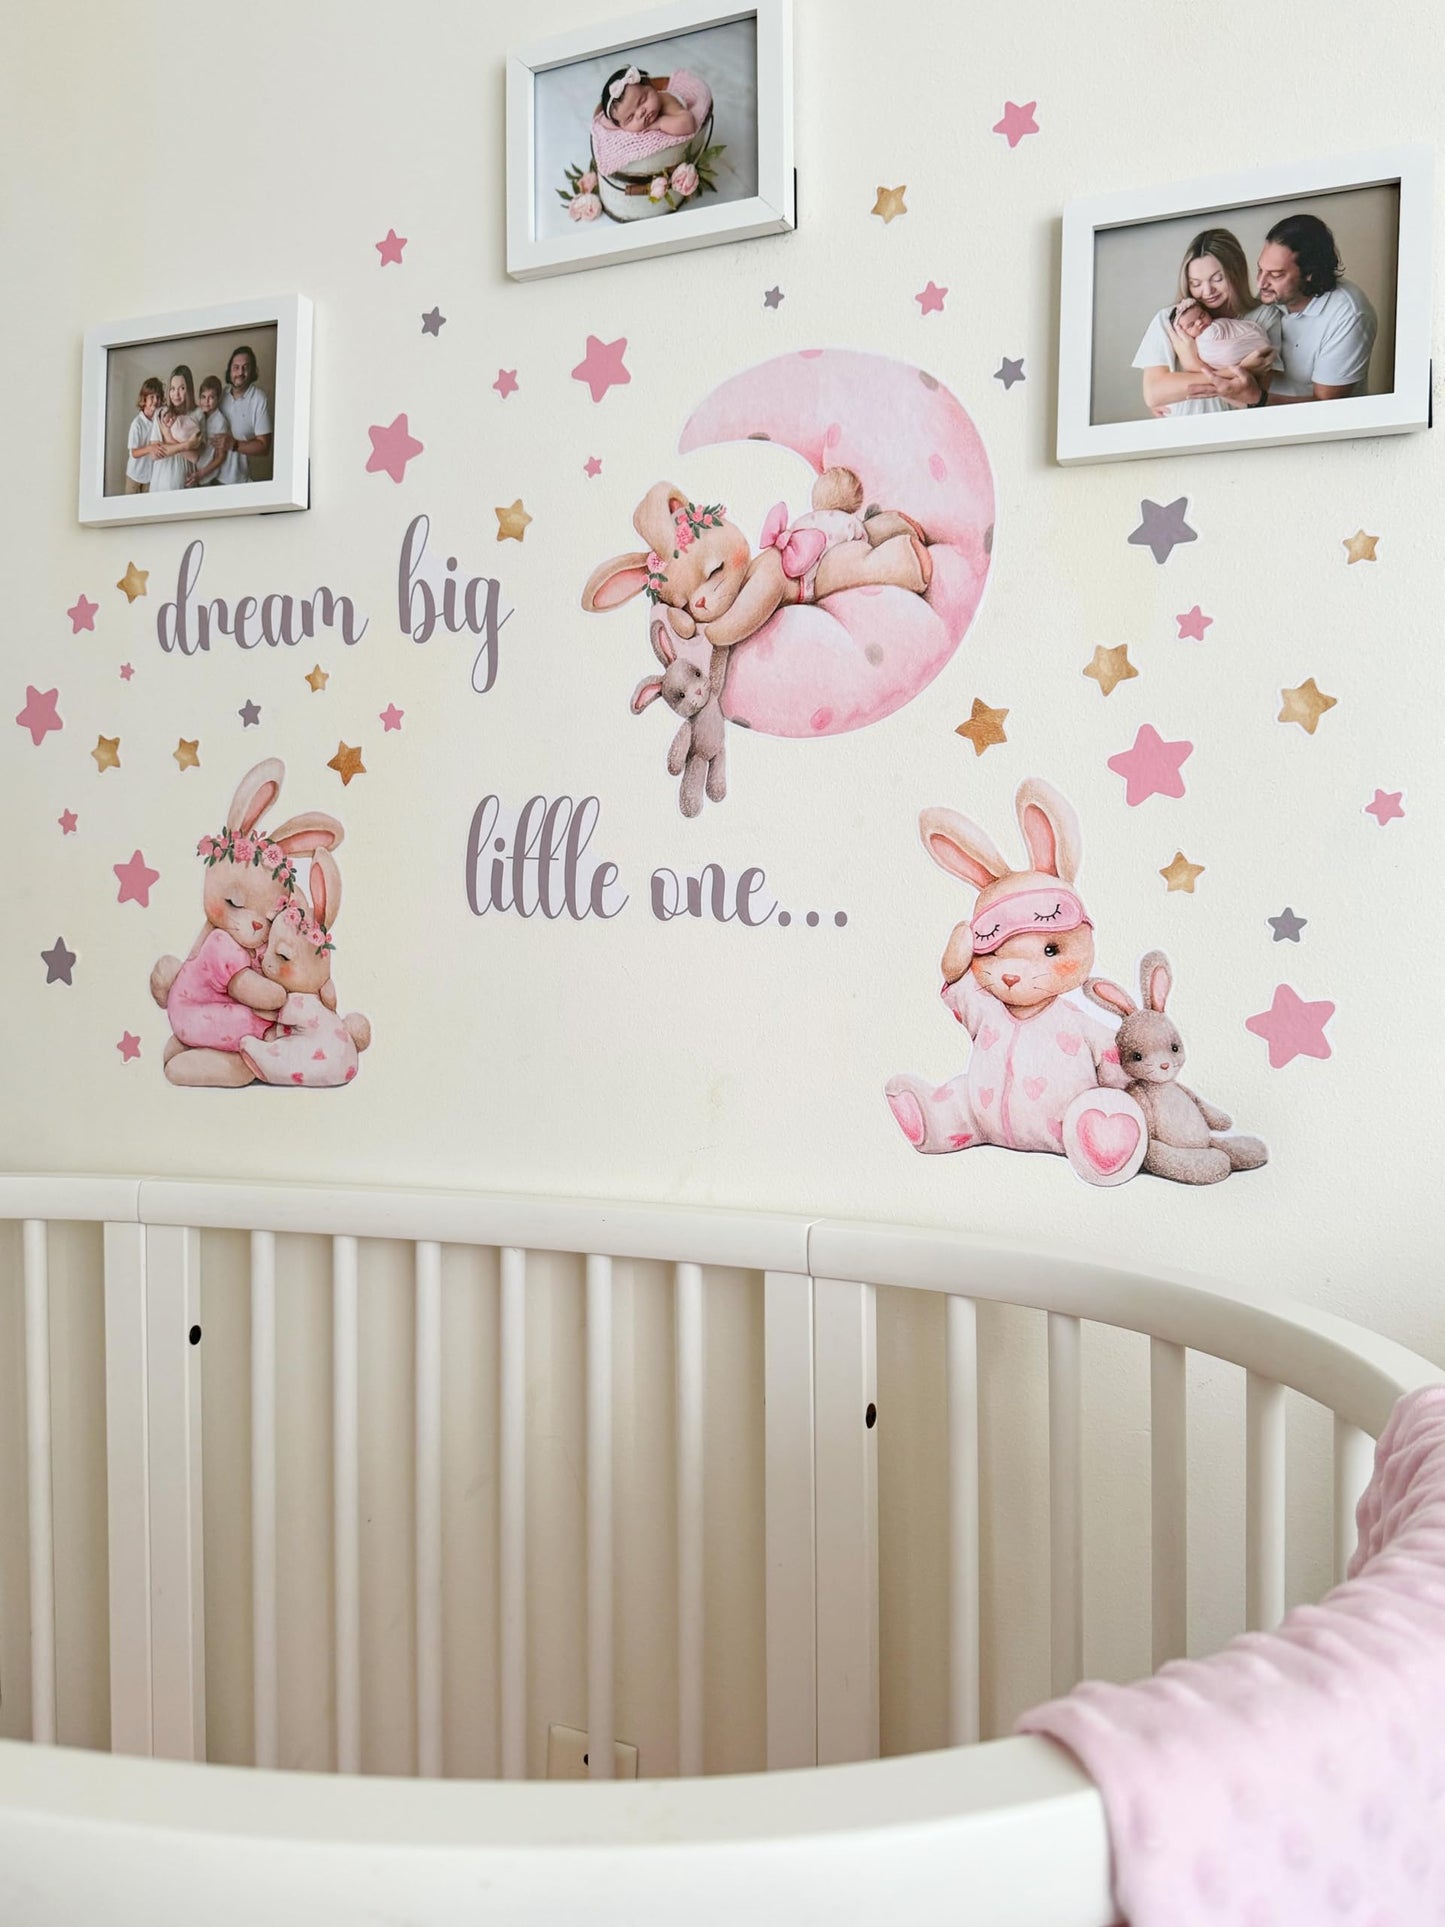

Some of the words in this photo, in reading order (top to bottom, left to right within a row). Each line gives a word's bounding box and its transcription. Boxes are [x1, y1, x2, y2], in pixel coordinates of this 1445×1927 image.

[156, 538, 370, 657] dream
[397, 513, 516, 695] big
[465, 794, 630, 922] little
[650, 863, 849, 928] one...
